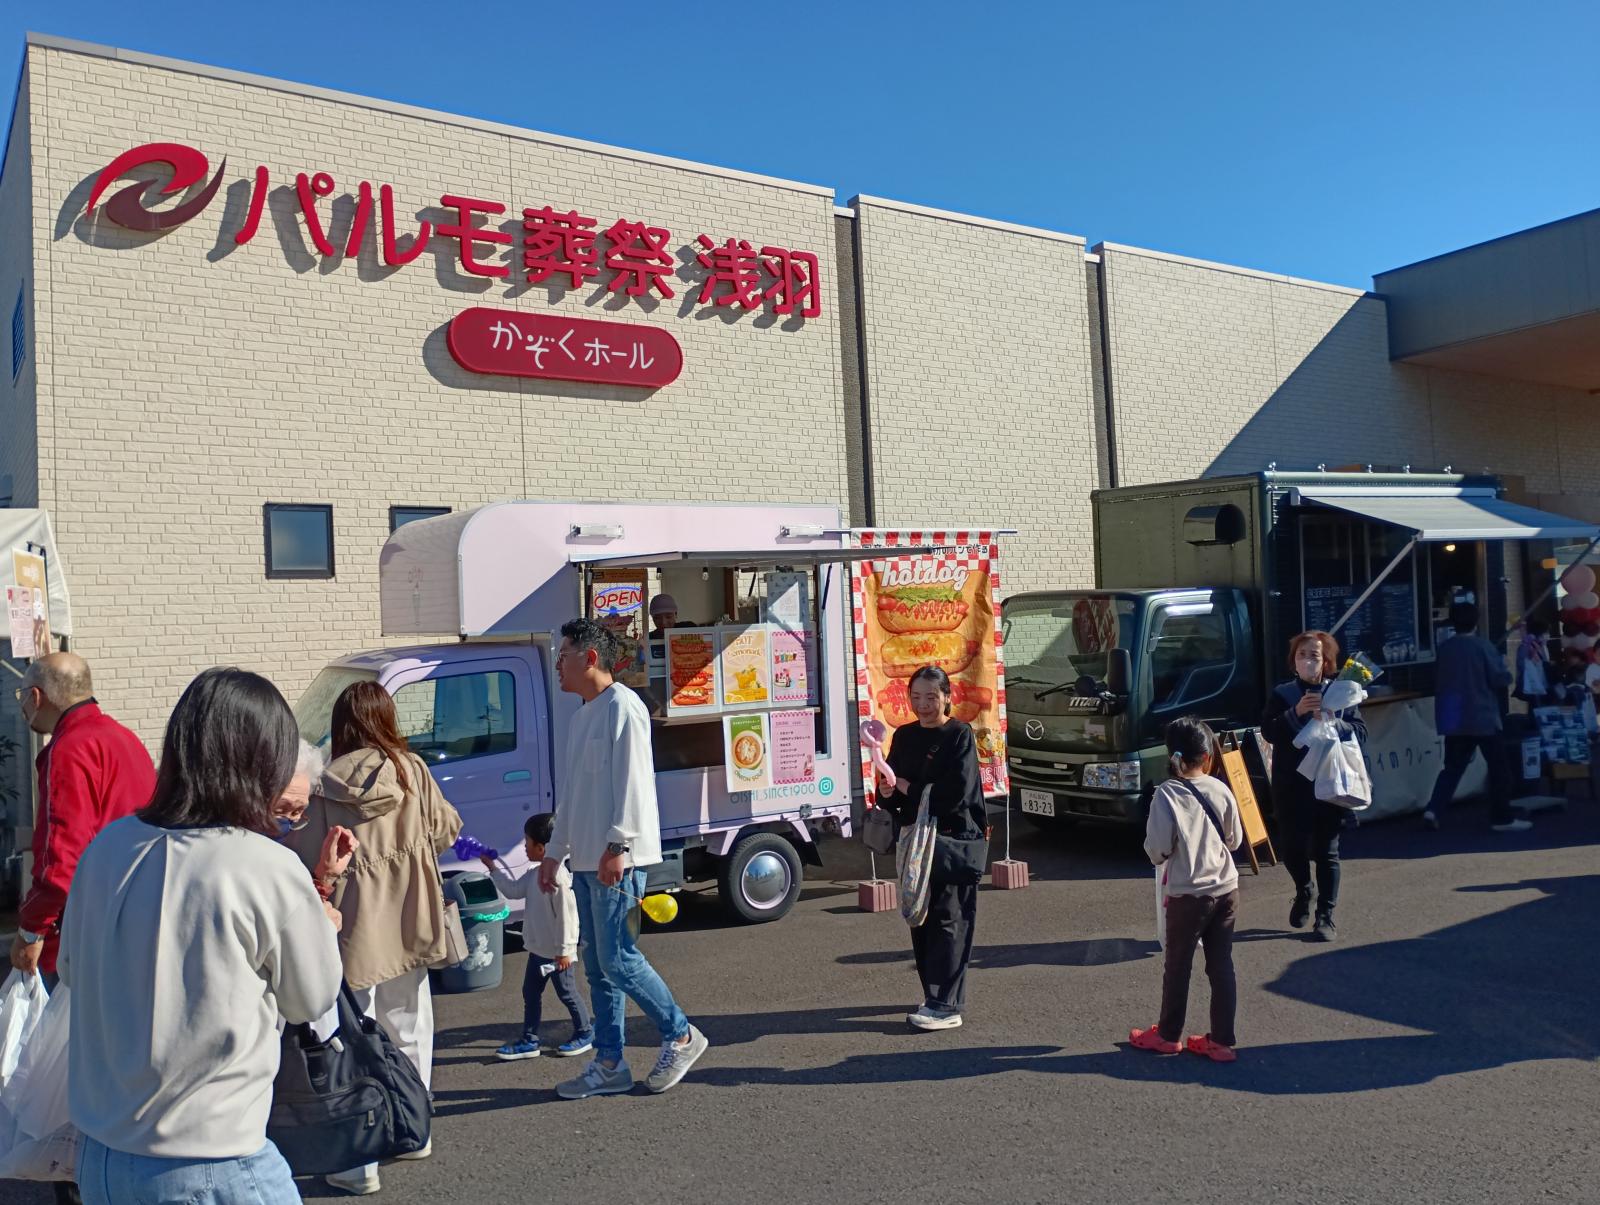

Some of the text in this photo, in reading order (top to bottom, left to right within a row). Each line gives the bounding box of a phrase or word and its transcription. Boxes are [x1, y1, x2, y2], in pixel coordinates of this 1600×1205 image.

[235, 165, 821, 318] パルモ葬祭 浅羽
[489, 320, 655, 370] かぞくホール
[880, 558, 970, 591] hotdog
[593, 589, 643, 609] OPEN
[1029, 800, 1053, 814] 83-23
